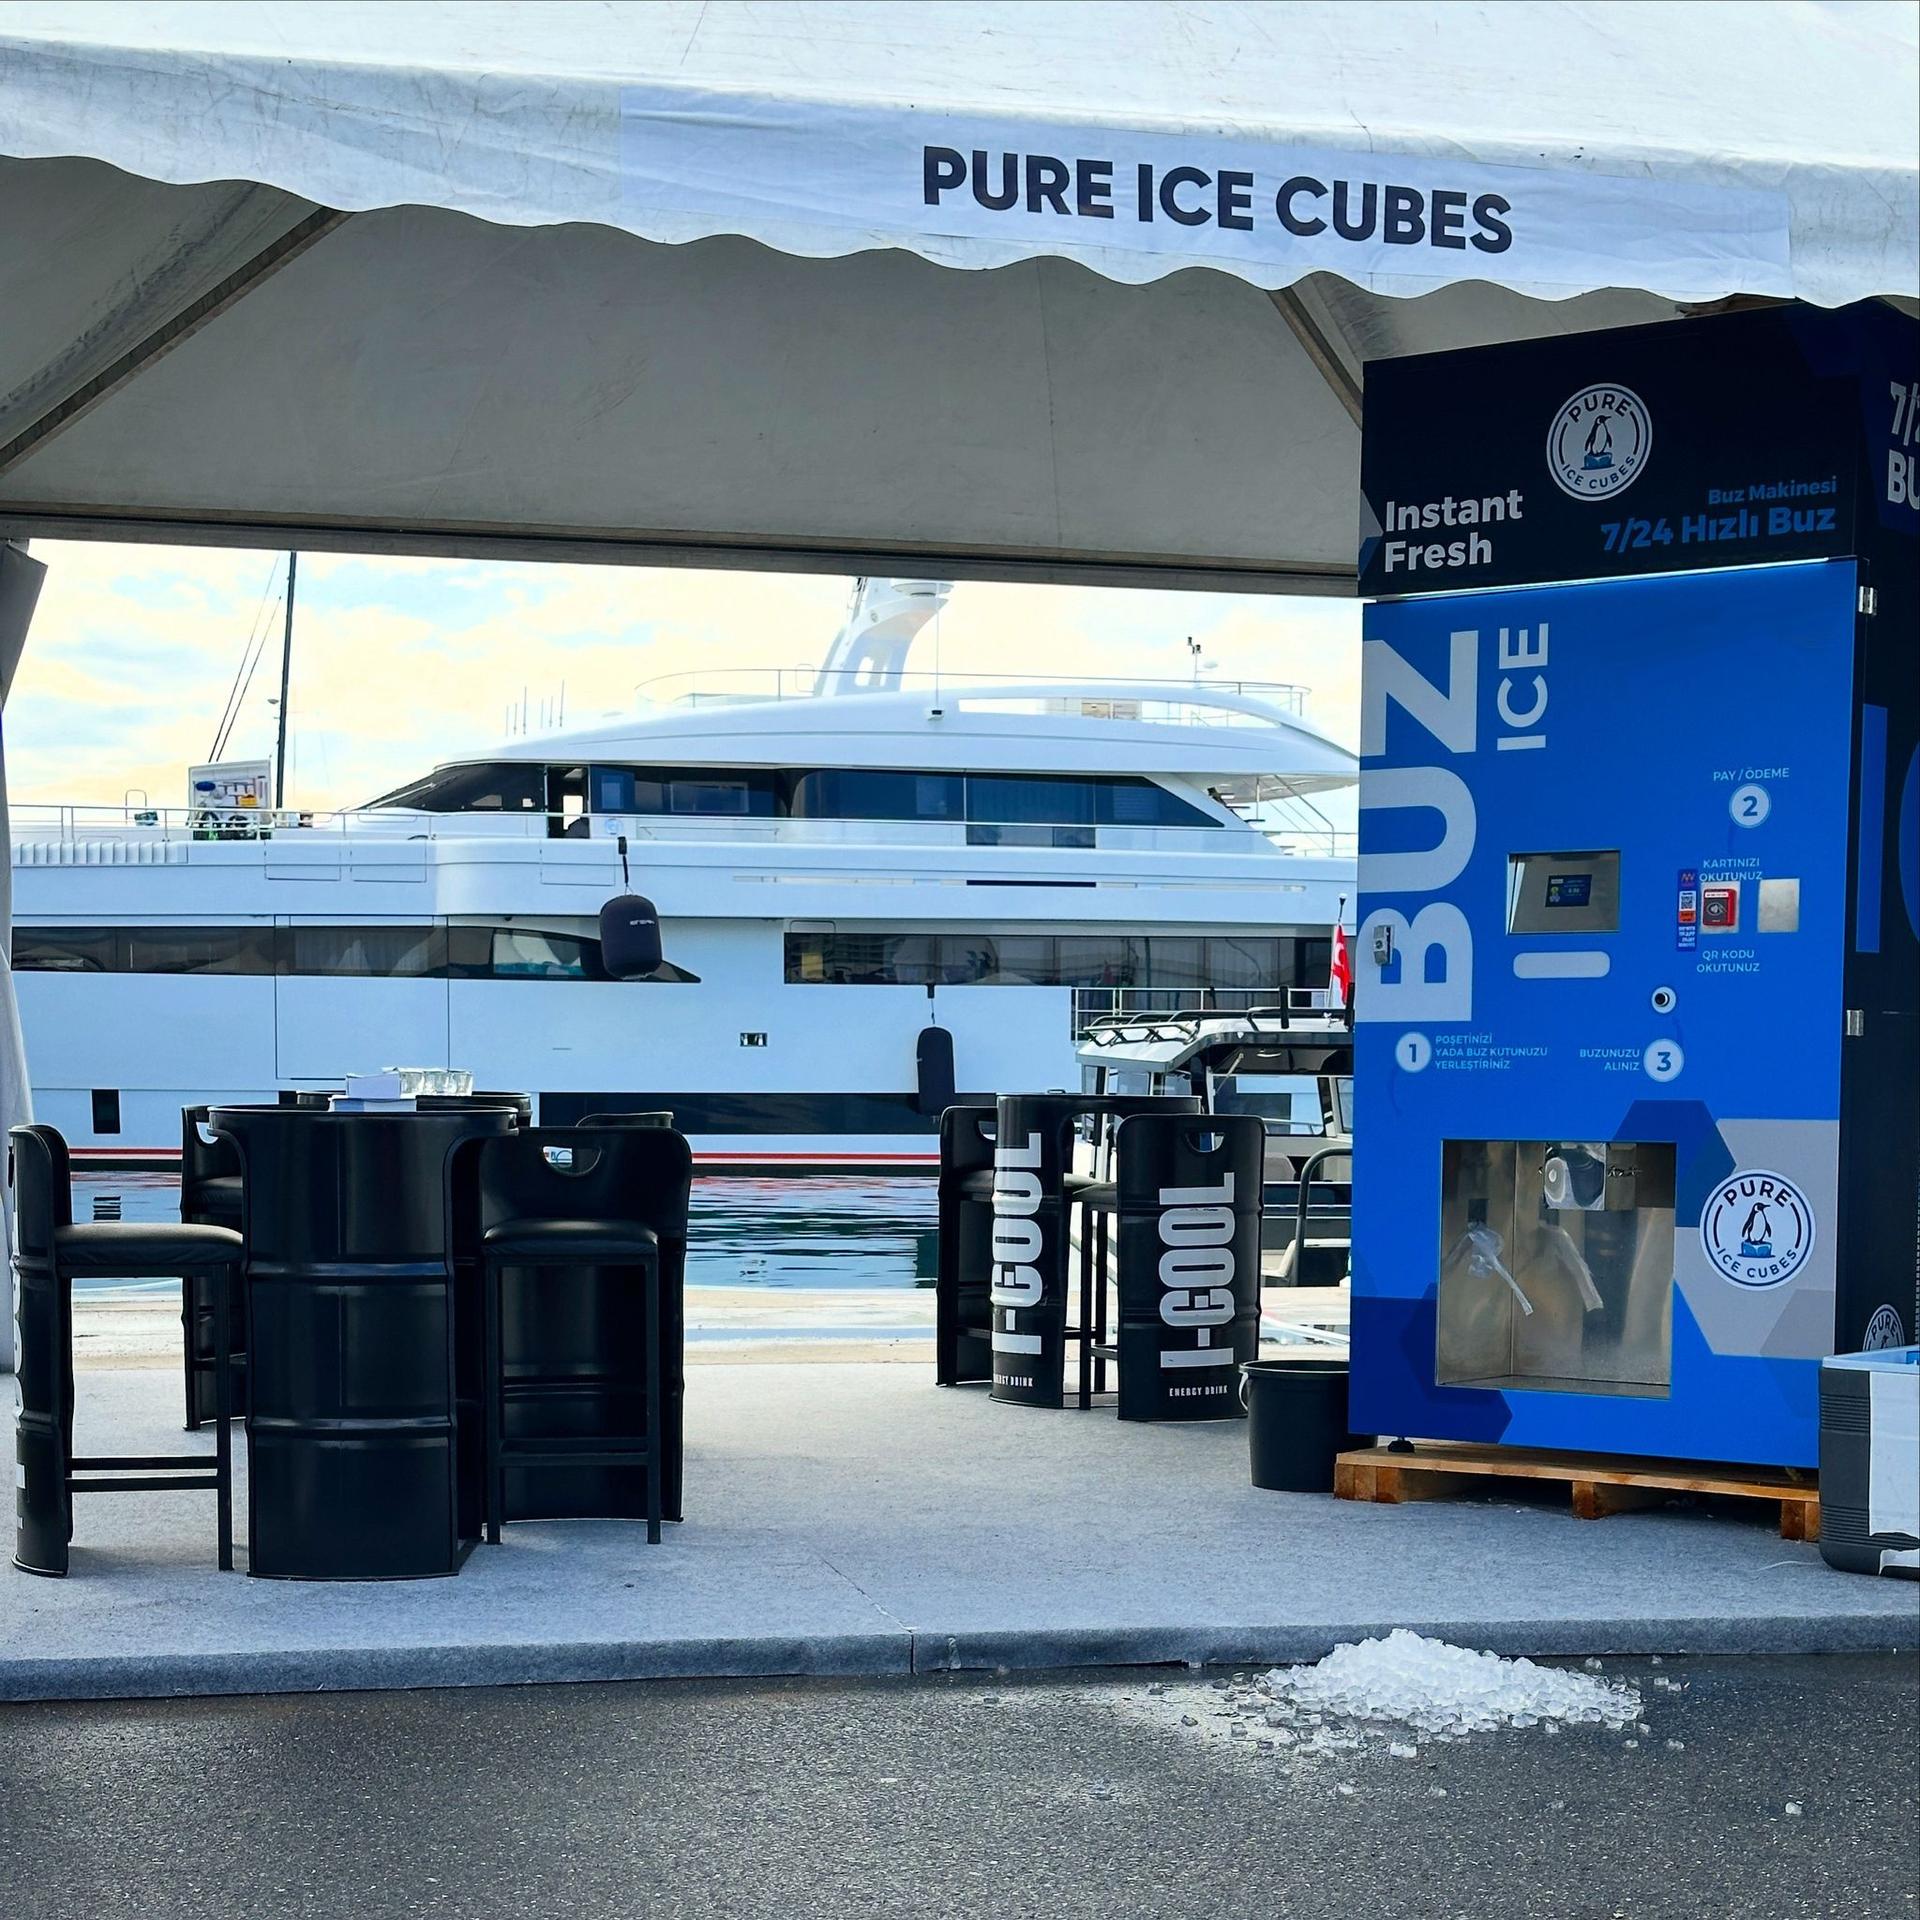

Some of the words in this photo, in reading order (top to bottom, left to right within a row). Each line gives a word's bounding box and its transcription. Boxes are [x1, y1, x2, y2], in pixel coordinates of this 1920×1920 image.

[924, 145, 1114, 219] PURE
[1138, 163, 1253, 231] ICE
[1276, 175, 1512, 253] CUBES
[1568, 393, 1631, 423] PURE
[1562, 464, 1584, 486] ICE
[1588, 456, 1635, 489] CUBES
[1708, 488, 1745, 505] Buz
[1749, 475, 1837, 501] Makinesi
[1386, 489, 1523, 532] Instant
[1600, 517, 1674, 554] 7/24
[1682, 508, 1759, 544] Hızlı
[1768, 506, 1836, 536] Buz
[1385, 532, 1492, 573] Fresh
[1497, 623, 1549, 751] ICE
[1713, 770, 1736, 781] PAY
[1745, 767, 1790, 779] ÖDEME
[1743, 795, 1758, 816] 2
[1354, 630, 1479, 1023] BUZ
[1699, 871, 1763, 882] OKUTUNUZ
[1703, 857, 1760, 868] KARTINIZI
[1696, 962, 1761, 973] OKUTUNUZ
[1702, 950, 1719, 961] QR
[1722, 949, 1755, 960] KODU
[1409, 1043, 1417, 1063] 1
[1435, 1047, 1464, 1057] YADA
[1466, 1047, 1487, 1057] BUZ
[1489, 1047, 1548, 1057] KUTUNUZU
[1579, 1048, 1640, 1058] BUZUNUZU
[1604, 1061, 1640, 1071] ALINIZ
[1656, 1051, 1672, 1072] 3
[1723, 1179, 1792, 1207] PURE
[990, 1132, 1043, 1355] I-COOL
[1158, 1172, 1236, 1368] I-COOL
[1717, 1248, 1741, 1273] ICE
[1746, 1249, 1797, 1279] CUBES
[1871, 1313, 1898, 1341] PURE
[1169, 1387, 1202, 1398] ENERGY
[1205, 1385, 1229, 1396] DRINK
